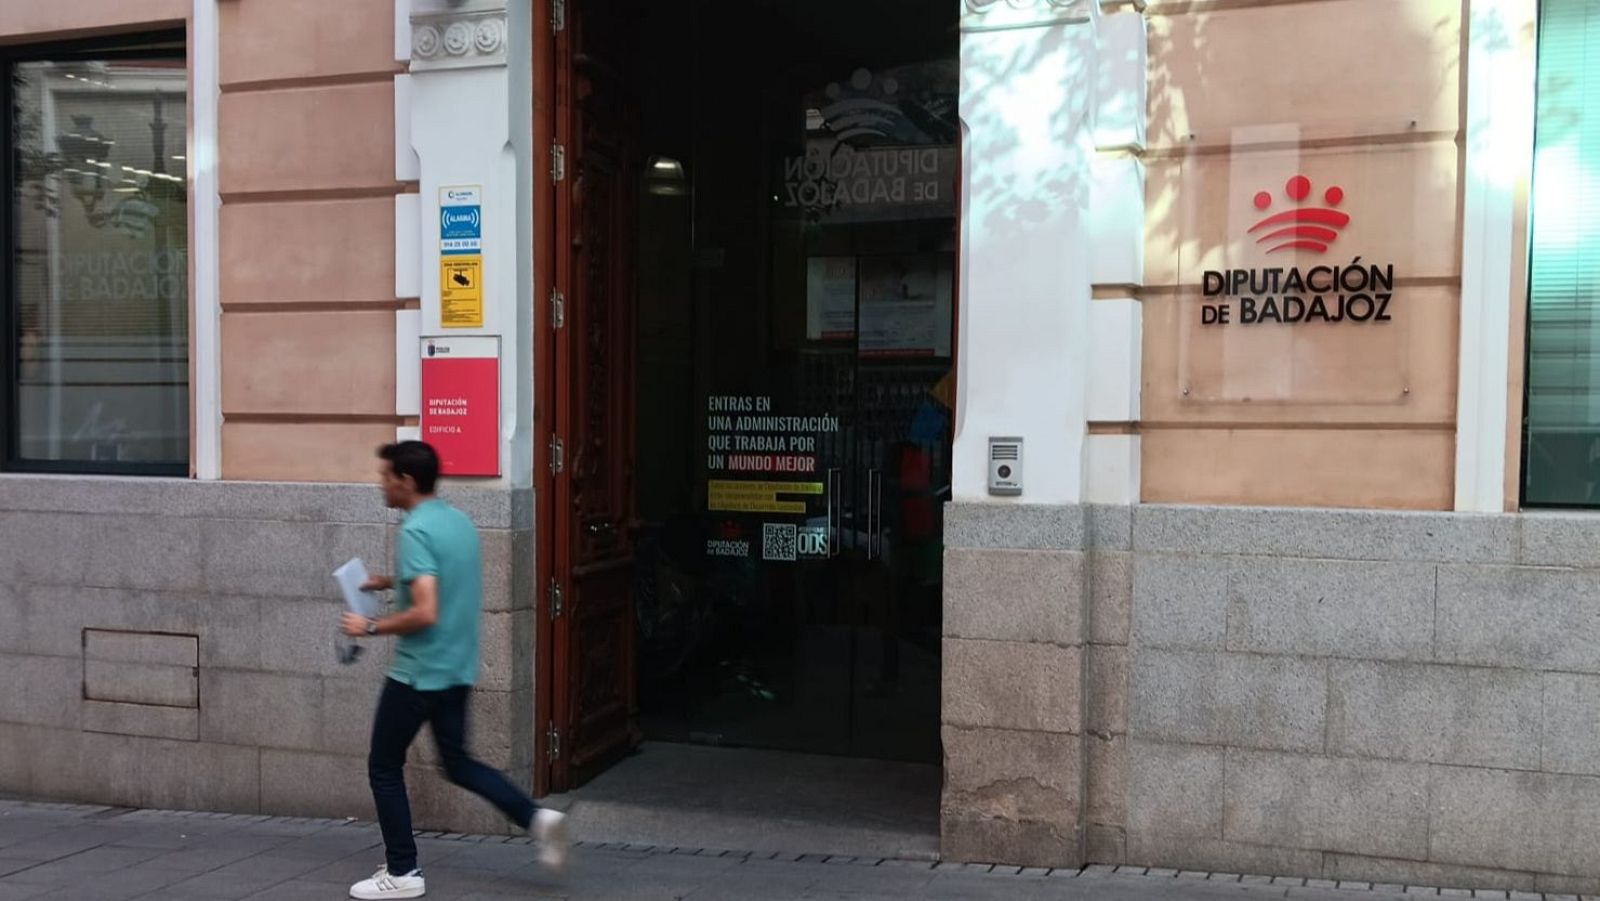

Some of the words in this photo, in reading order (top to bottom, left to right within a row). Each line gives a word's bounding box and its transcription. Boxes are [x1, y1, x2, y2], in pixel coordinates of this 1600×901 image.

[449, 214, 472, 222] ALARMA
[1202, 256, 1393, 296] DIPUTACIÓN
[1202, 305, 1230, 324] DE
[1239, 293, 1392, 324] BADAJOZ
[429, 398, 467, 406] DIPUTACIÓN
[708, 396, 752, 411] ENTRAS
[756, 396, 770, 411] EN
[429, 407, 437, 415] DE
[438, 407, 467, 415] BADAJOZ
[708, 415, 732, 431] UNA
[735, 412, 839, 432] ADMINISTRACIÓN
[708, 435, 731, 451] QUE
[734, 435, 786, 451] TRABAJA
[790, 436, 815, 452] POR
[708, 455, 724, 469] UN
[728, 455, 771, 471] MUNDO
[775, 456, 815, 472] MEJOR
[798, 533, 827, 555] ODS
